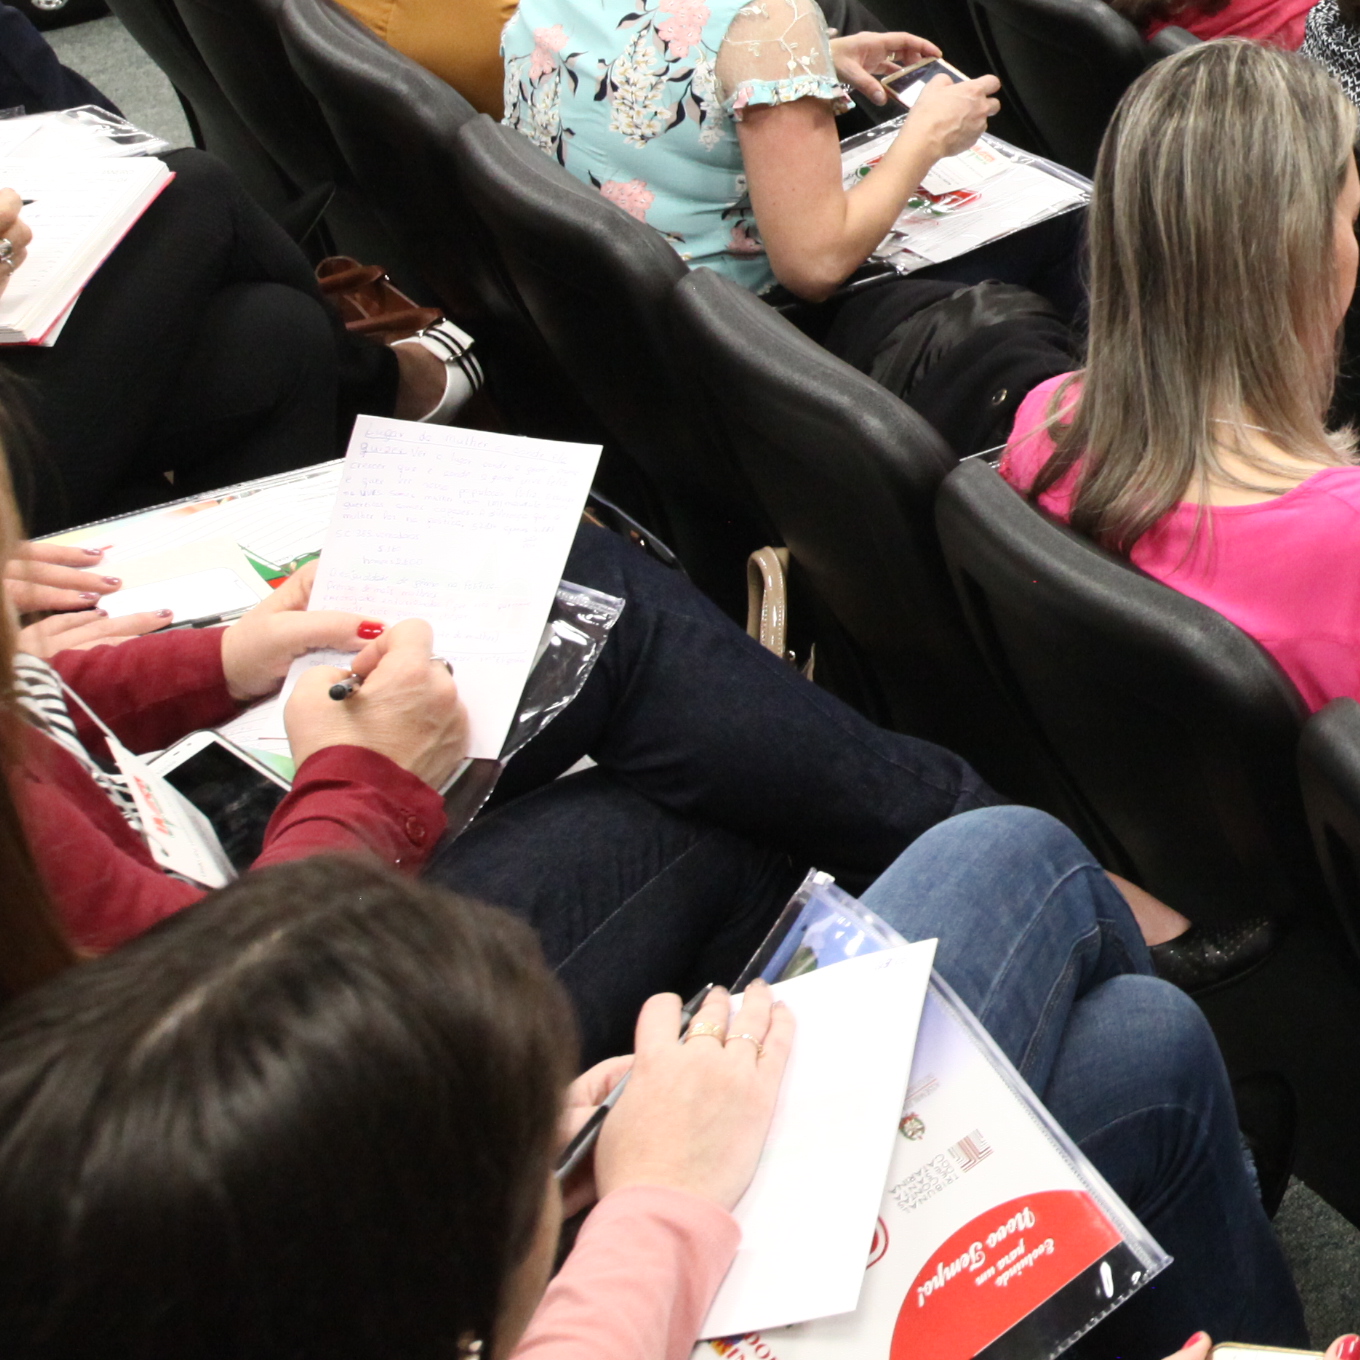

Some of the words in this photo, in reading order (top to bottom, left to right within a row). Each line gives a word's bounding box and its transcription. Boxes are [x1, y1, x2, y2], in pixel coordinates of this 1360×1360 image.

[901, 1174, 960, 1214] TRIBUNAL
[987, 1206, 1035, 1248] Novo
[917, 1241, 986, 1308] Tempo!
[993, 1238, 1026, 1272] para
[994, 1237, 1055, 1287] Evoluindo
[974, 1269, 996, 1286] um
